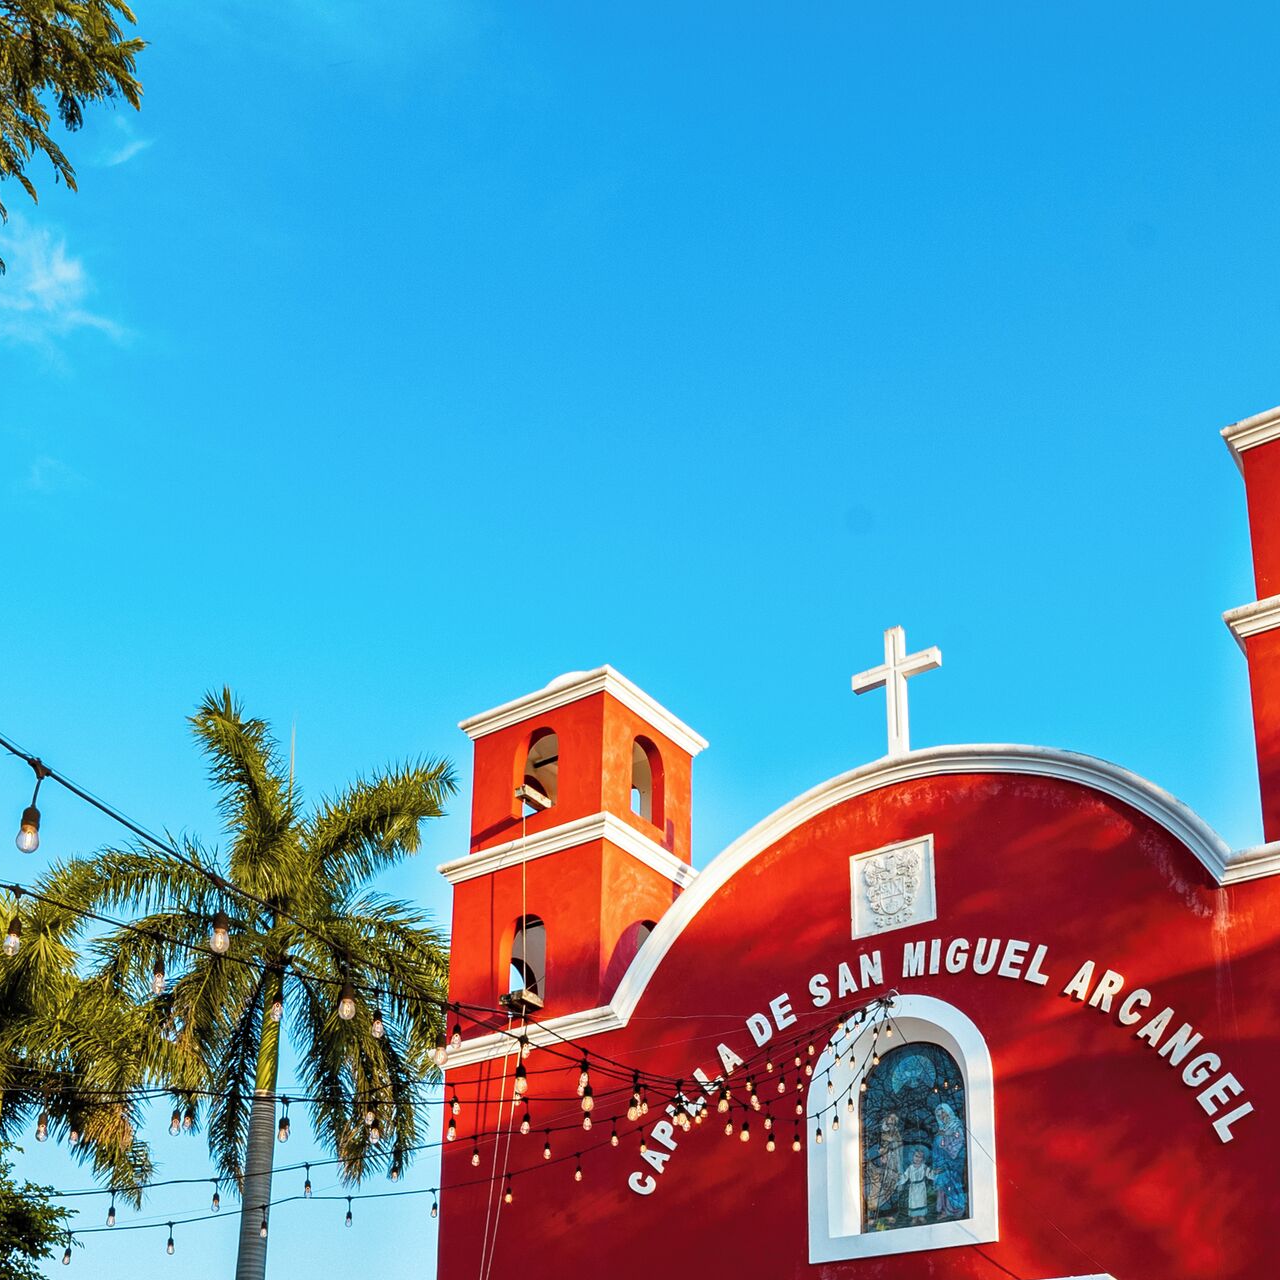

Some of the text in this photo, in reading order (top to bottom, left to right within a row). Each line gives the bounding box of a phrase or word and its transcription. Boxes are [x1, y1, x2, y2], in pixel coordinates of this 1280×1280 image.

[747, 993, 797, 1047] DE
[809, 950, 884, 1007] SAN
[902, 938, 1049, 986] MIGUEL
[1064, 960, 1254, 1143] ARCANGEL
